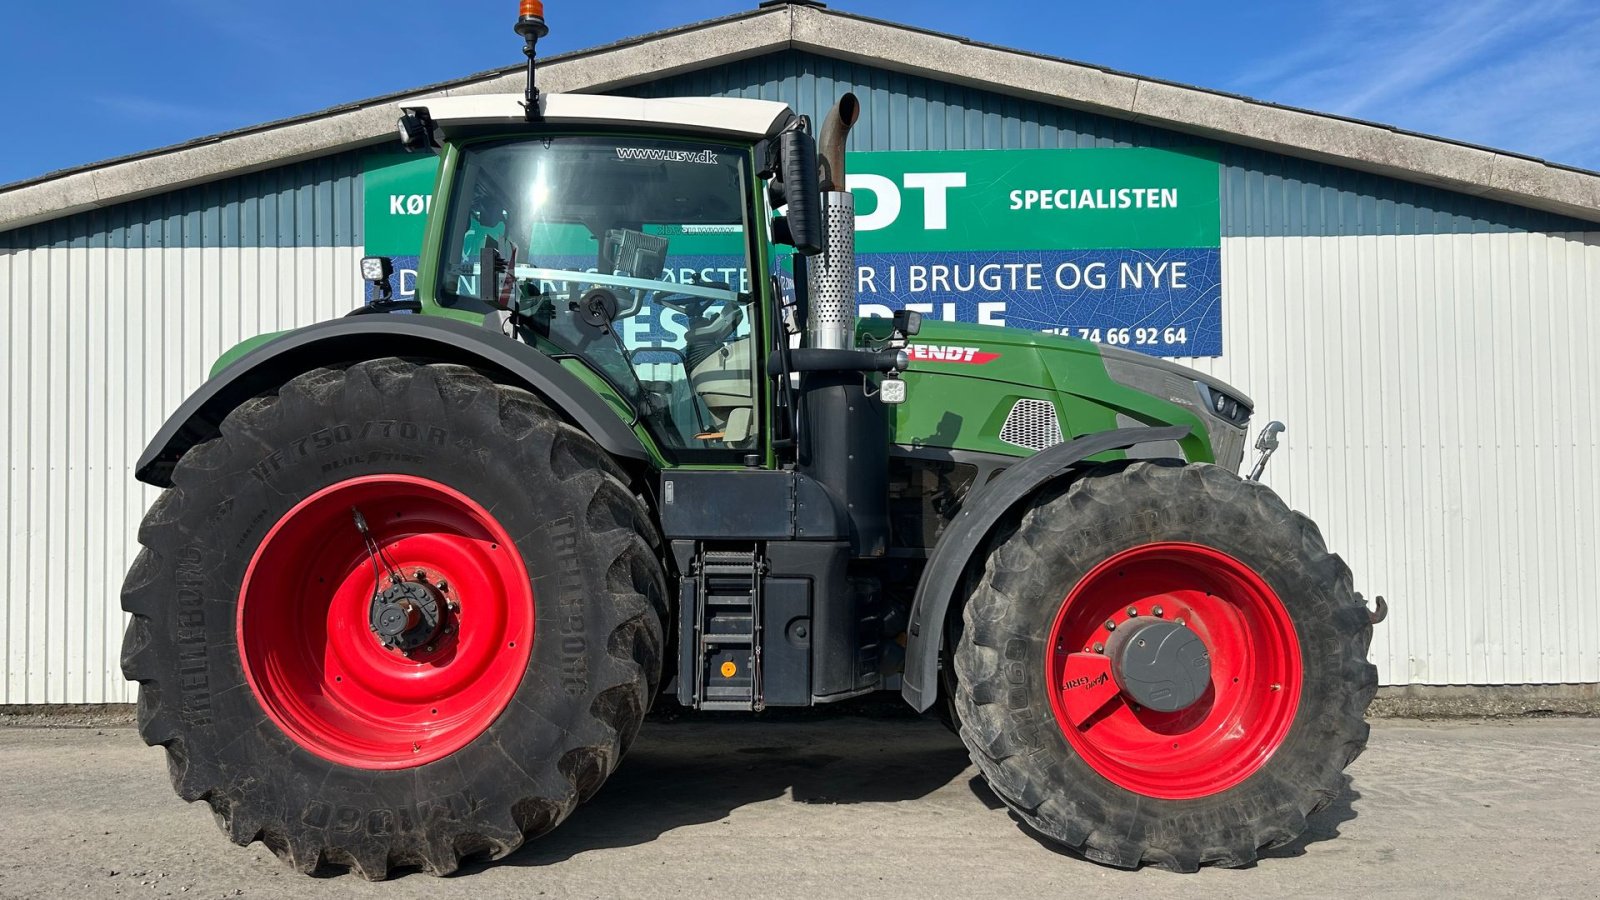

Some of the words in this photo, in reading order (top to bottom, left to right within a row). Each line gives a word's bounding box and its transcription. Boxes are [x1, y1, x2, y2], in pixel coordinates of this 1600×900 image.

[616, 147, 718, 165] www.usv.dk
[1010, 188, 1178, 210] SPECIALISTEN
[910, 263, 1042, 292] BRUGTE
[1055, 262, 1106, 290] OG
[1121, 262, 1187, 289] NYE
[1107, 327, 1130, 344] 66
[1136, 327, 1158, 344] 92
[1164, 327, 1187, 344] 64
[901, 343, 980, 361] FENDT
